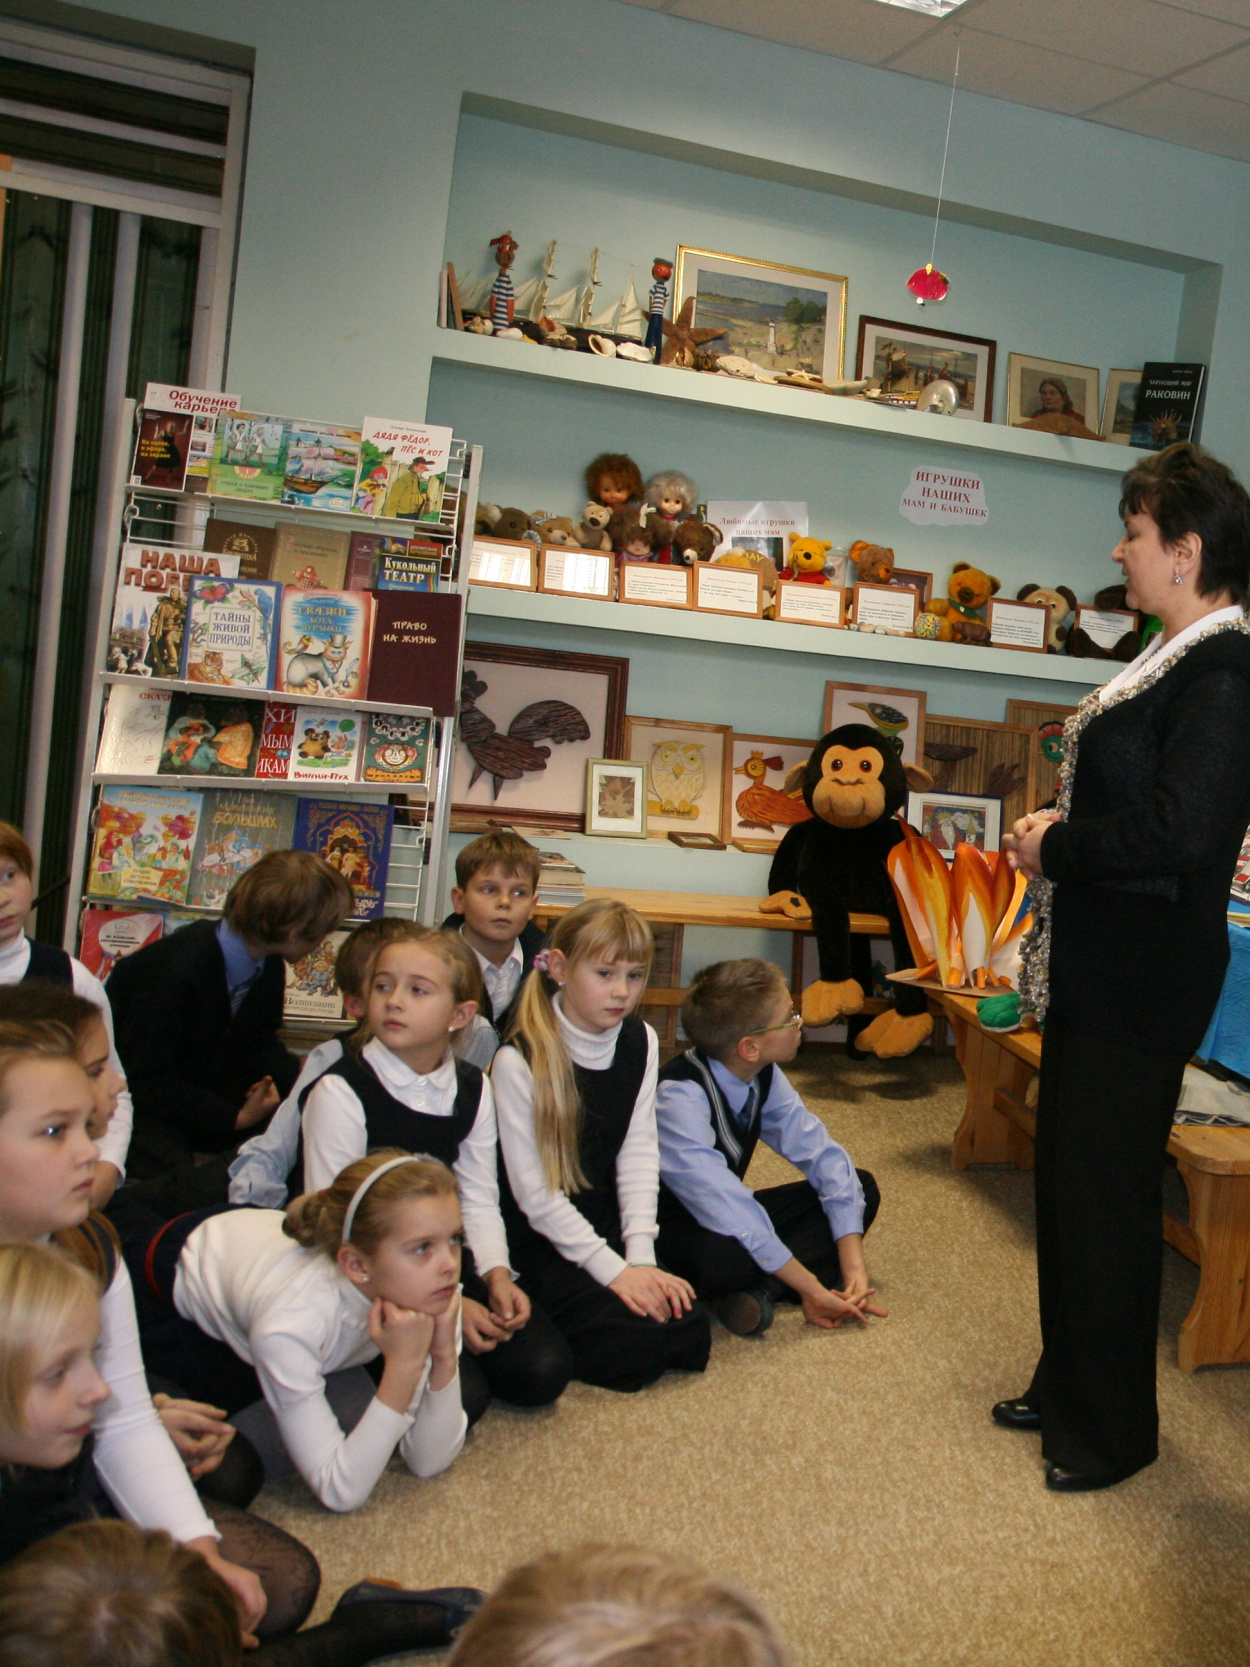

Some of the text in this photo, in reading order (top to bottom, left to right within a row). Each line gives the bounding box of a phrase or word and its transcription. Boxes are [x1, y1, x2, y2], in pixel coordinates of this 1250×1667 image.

[169, 390, 237, 408] Обучение
[1145, 389, 1191, 400] РАКОВИН
[372, 431, 431, 446] ДЯДЯ ФЁДОР,
[401, 445, 416, 454] ПЁС
[426, 449, 443, 458] КОТ
[916, 471, 980, 490] ИГРУШКИ
[922, 487, 971, 504] НАШИХ
[902, 498, 988, 518] МАМ И БАБУШЕК
[720, 518, 795, 527] Любимые игрушки
[140, 549, 222, 577] НАША
[385, 556, 436, 574] Кукольный
[124, 567, 191, 592] ПОБ
[384, 570, 425, 584] ТЕАТР
[214, 611, 251, 623] ТАЙНЫ
[298, 606, 347, 616] СКАЗКИ
[212, 622, 250, 634] ЖИВОЙ
[392, 620, 428, 630] ПРАВО
[210, 633, 251, 646] ПРИРОДЫ
[383, 634, 436, 644] НА ЖИЗНЬ
[212, 811, 277, 829] БОЛЬШИХ
